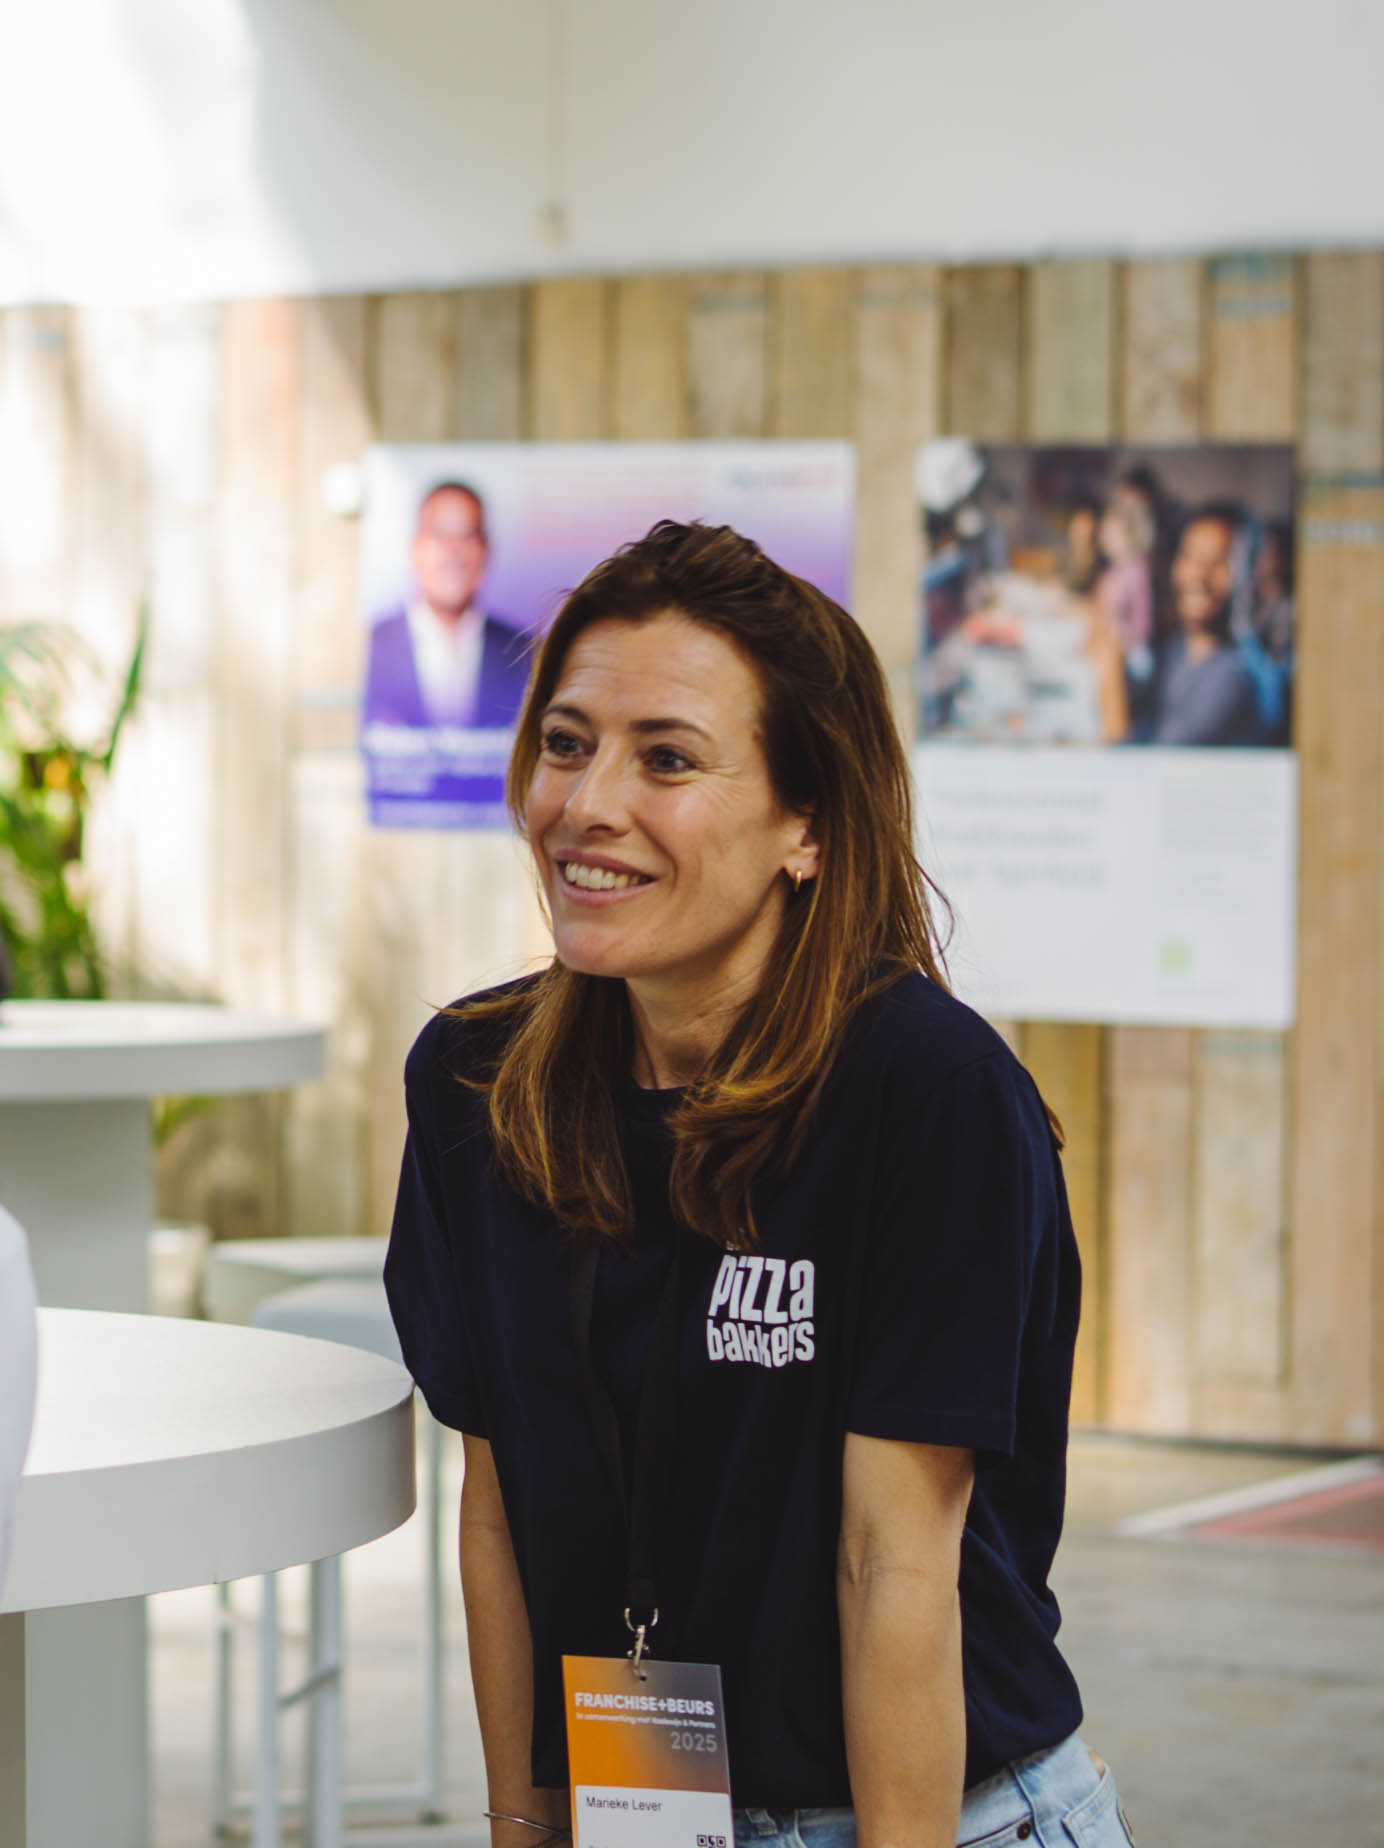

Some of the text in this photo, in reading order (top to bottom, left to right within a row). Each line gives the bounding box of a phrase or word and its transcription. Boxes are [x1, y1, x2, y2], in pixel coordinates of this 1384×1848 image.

[708, 1254, 815, 1324] pizza
[707, 1319, 815, 1368] bakkers
[574, 1692, 715, 1716] FRANCHISE+BEURS
[671, 1731, 718, 1753] 2025
[586, 1796, 663, 1811] Marieke Lever
